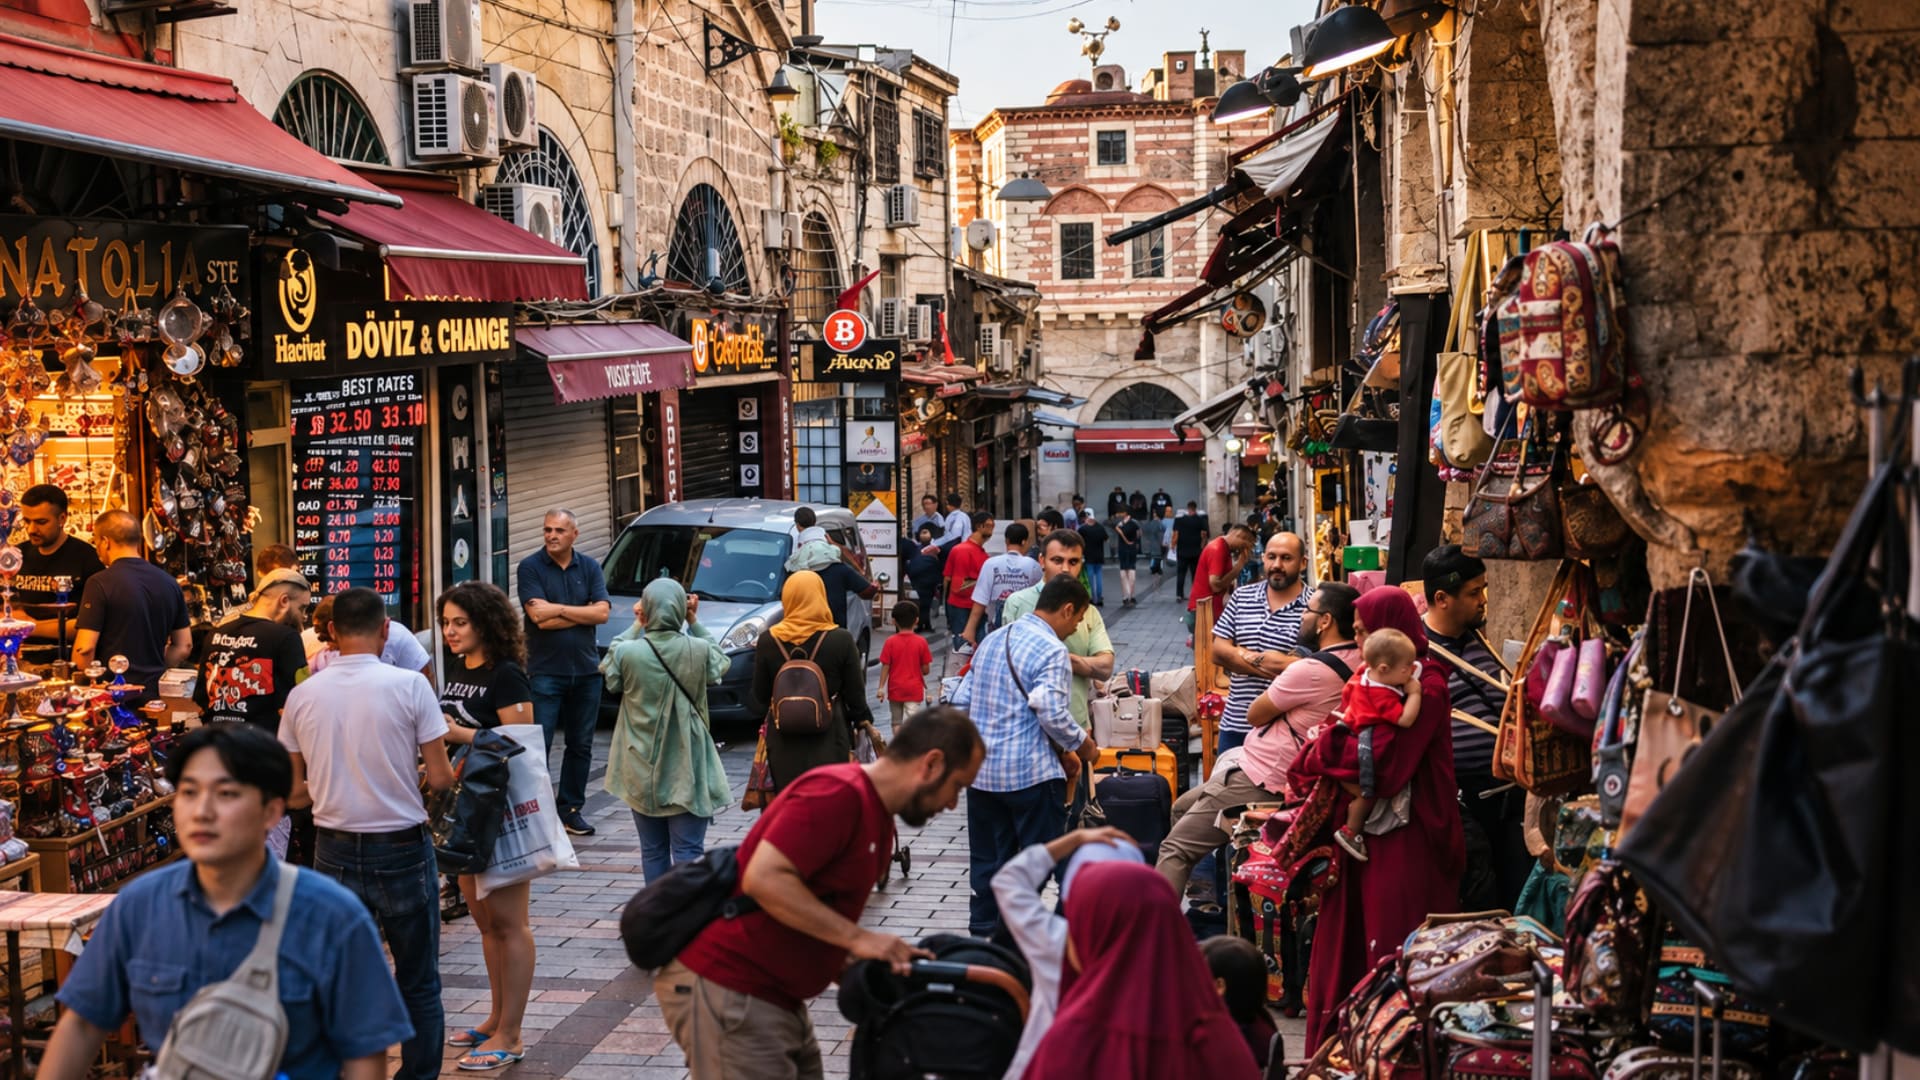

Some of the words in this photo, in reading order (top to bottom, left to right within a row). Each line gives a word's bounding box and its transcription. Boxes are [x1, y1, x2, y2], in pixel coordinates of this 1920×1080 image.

[206, 260, 239, 284] STE
[346, 309, 416, 360] DÖVİZ
[420, 324, 434, 355] &
[437, 317, 510, 353] CHANGE
[342, 377, 373, 397] BEST
[376, 374, 415, 393] RATES
[330, 408, 372, 434] 32.50
[301, 477, 325, 490] CHF
[296, 514, 320, 526] CAD
